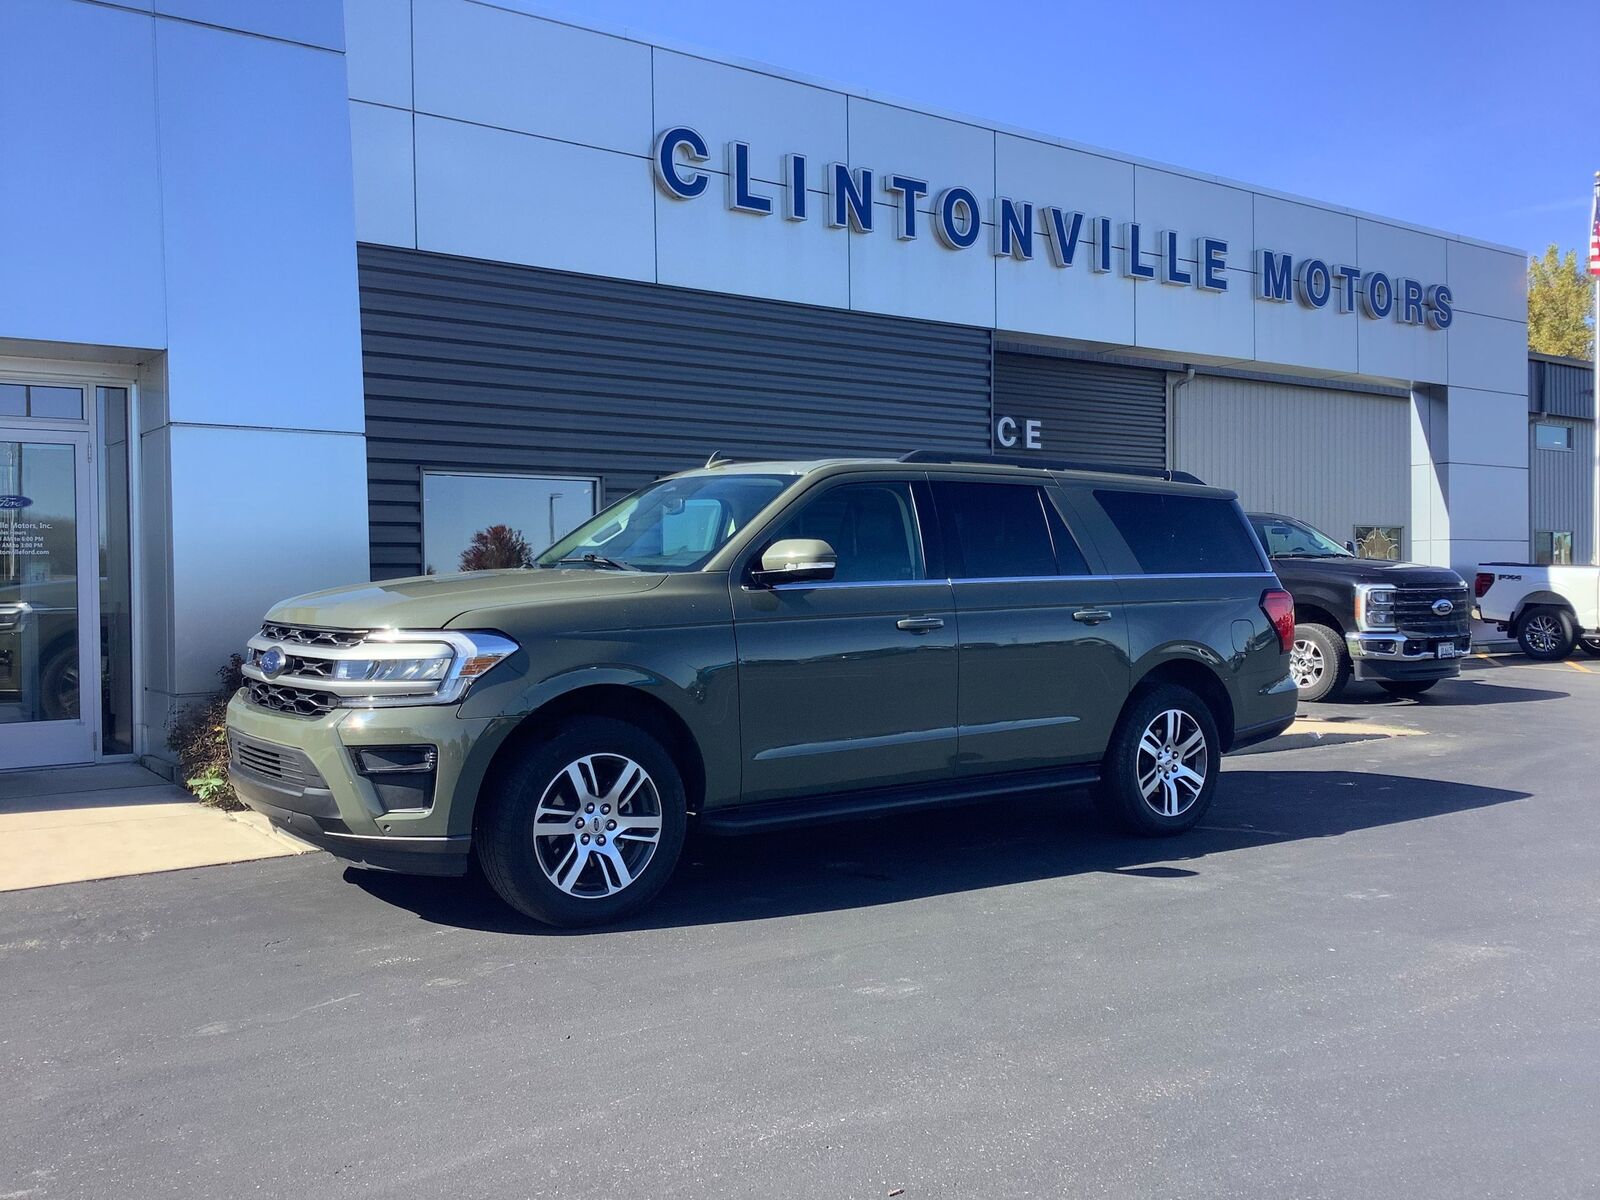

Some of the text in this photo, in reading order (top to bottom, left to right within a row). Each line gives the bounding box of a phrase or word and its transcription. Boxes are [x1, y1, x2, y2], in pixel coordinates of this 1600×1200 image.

[655, 126, 1454, 331] CLINTONVILLE MOTORS
[997, 416, 1042, 449] CE
